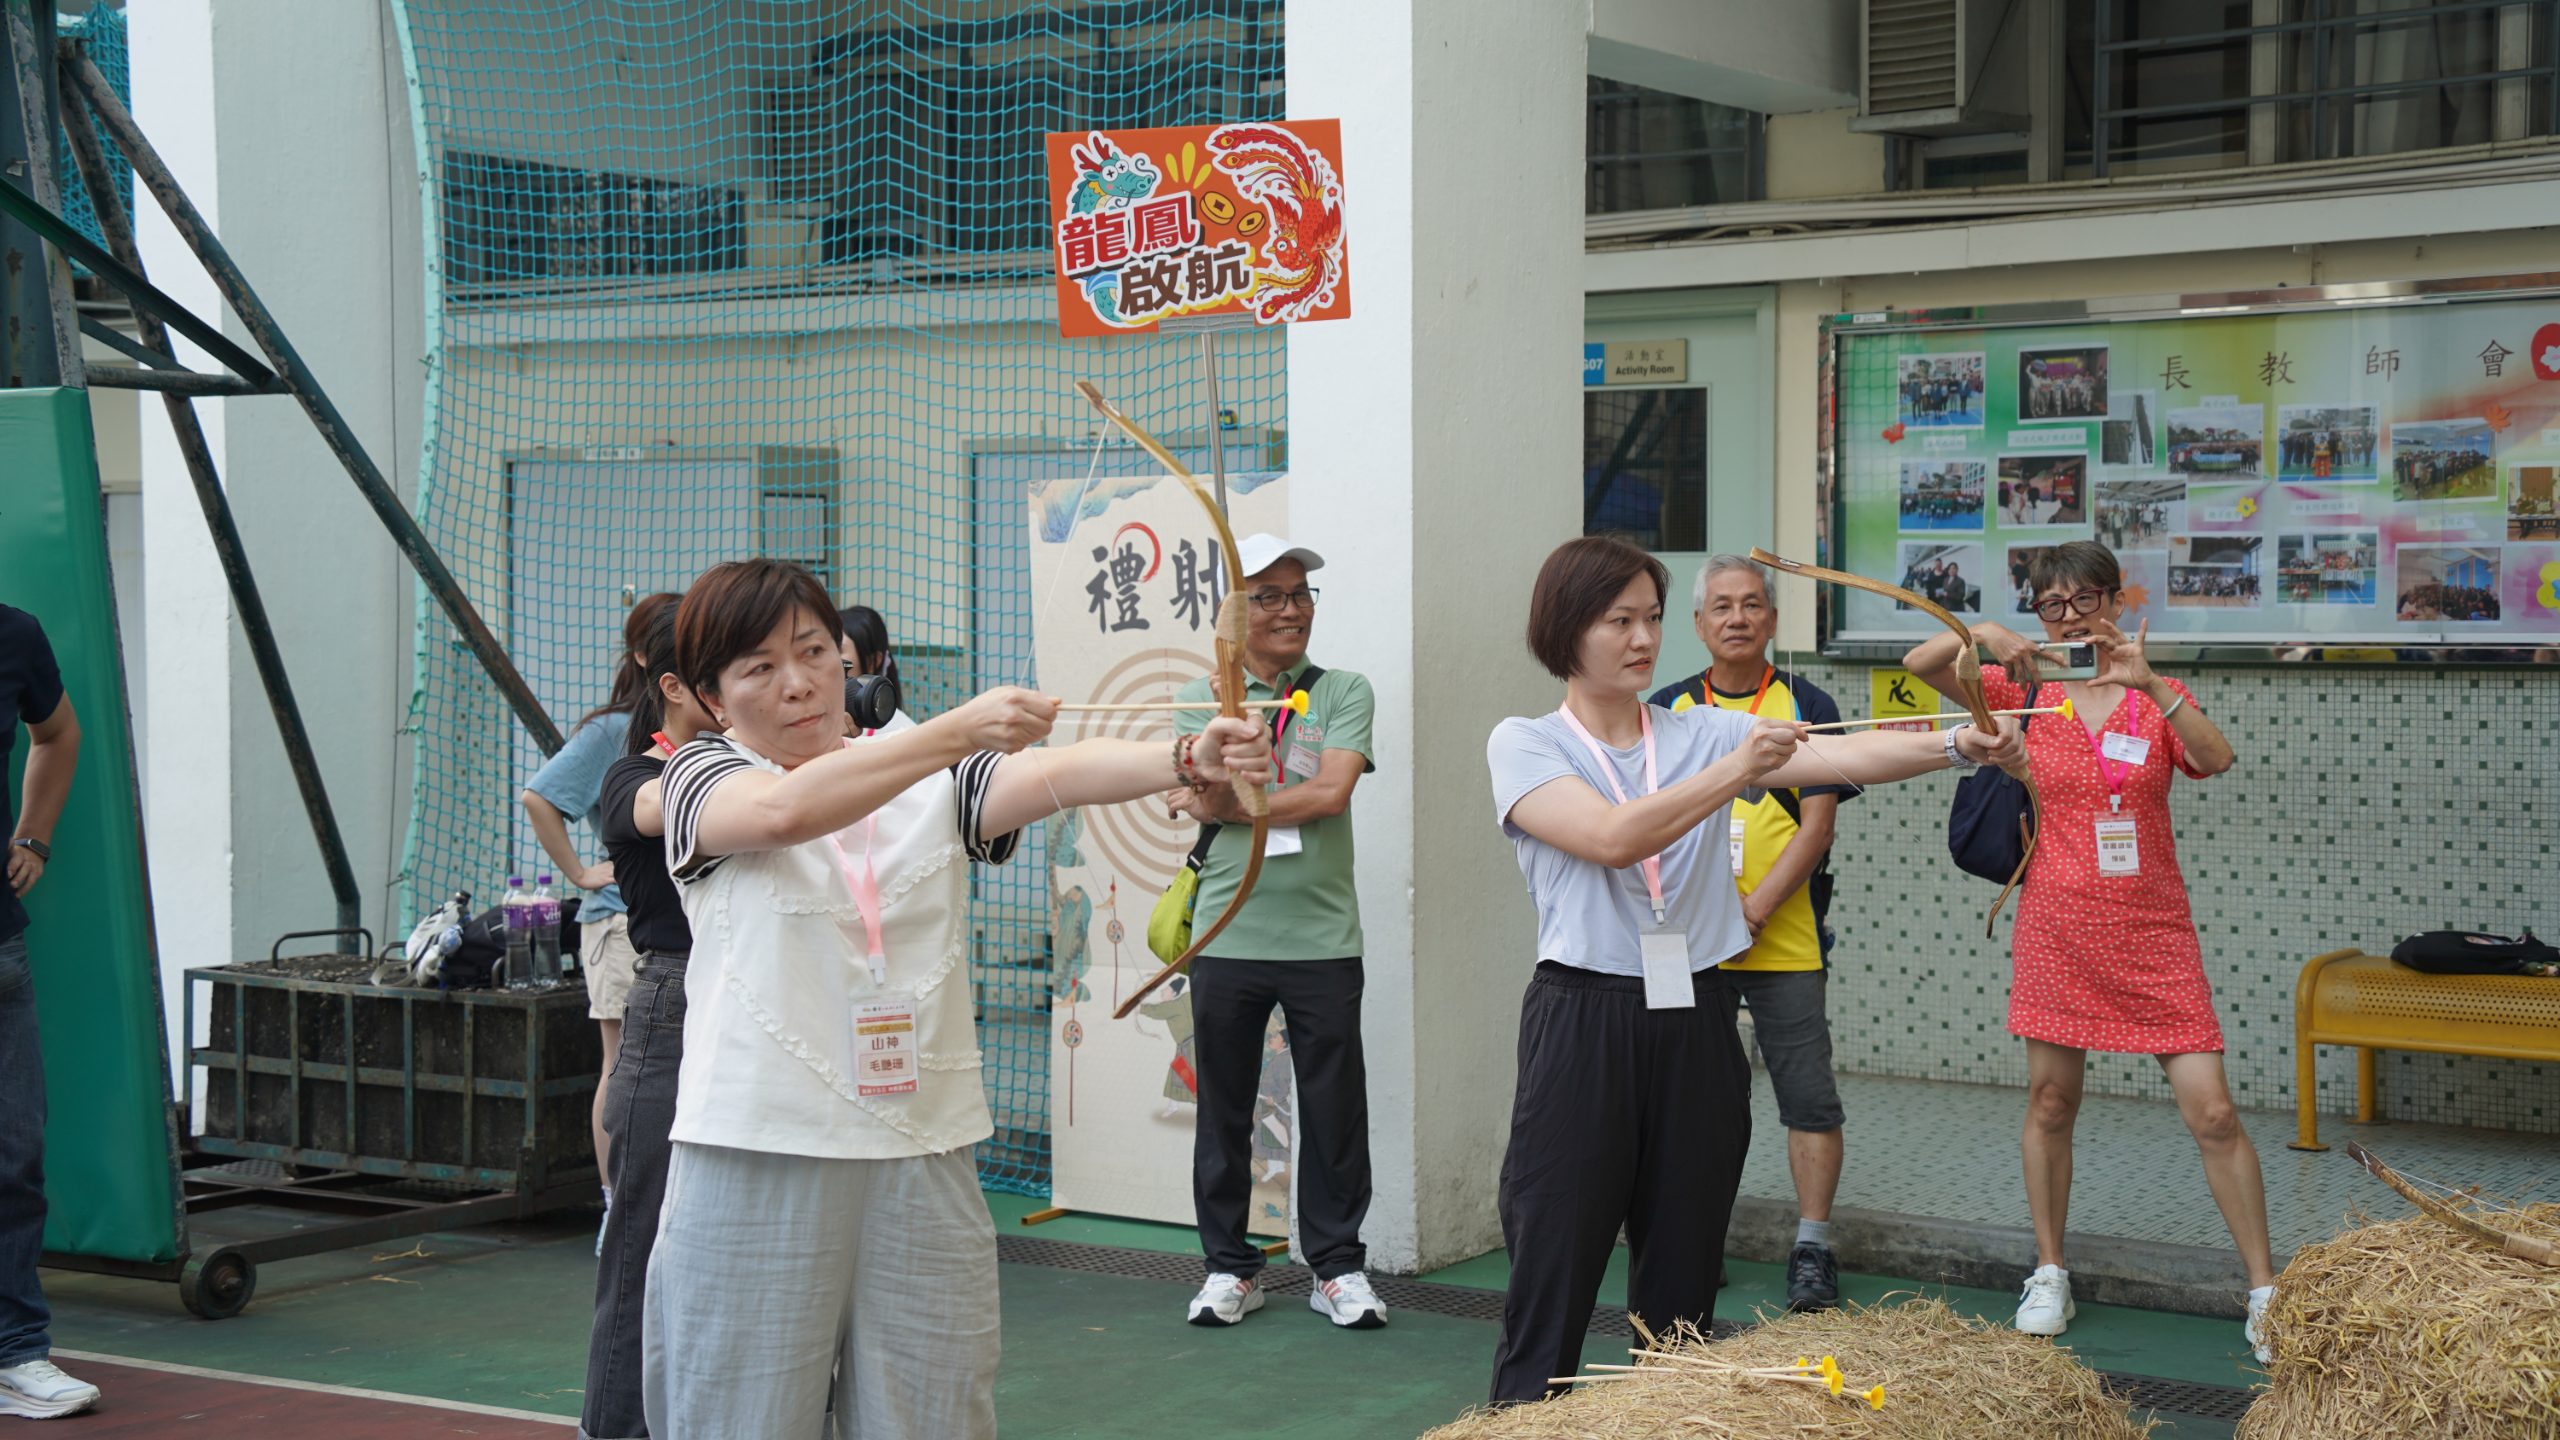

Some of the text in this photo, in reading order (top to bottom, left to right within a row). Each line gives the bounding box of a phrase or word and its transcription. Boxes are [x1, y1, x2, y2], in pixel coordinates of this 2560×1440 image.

[1062, 195, 1196, 271] 龍鳳
[1118, 243, 1250, 316] 啟航
[1616, 365, 1674, 376] Activity Room
[2159, 339, 2514, 391] 長教師會
[872, 1035, 899, 1050] 山神
